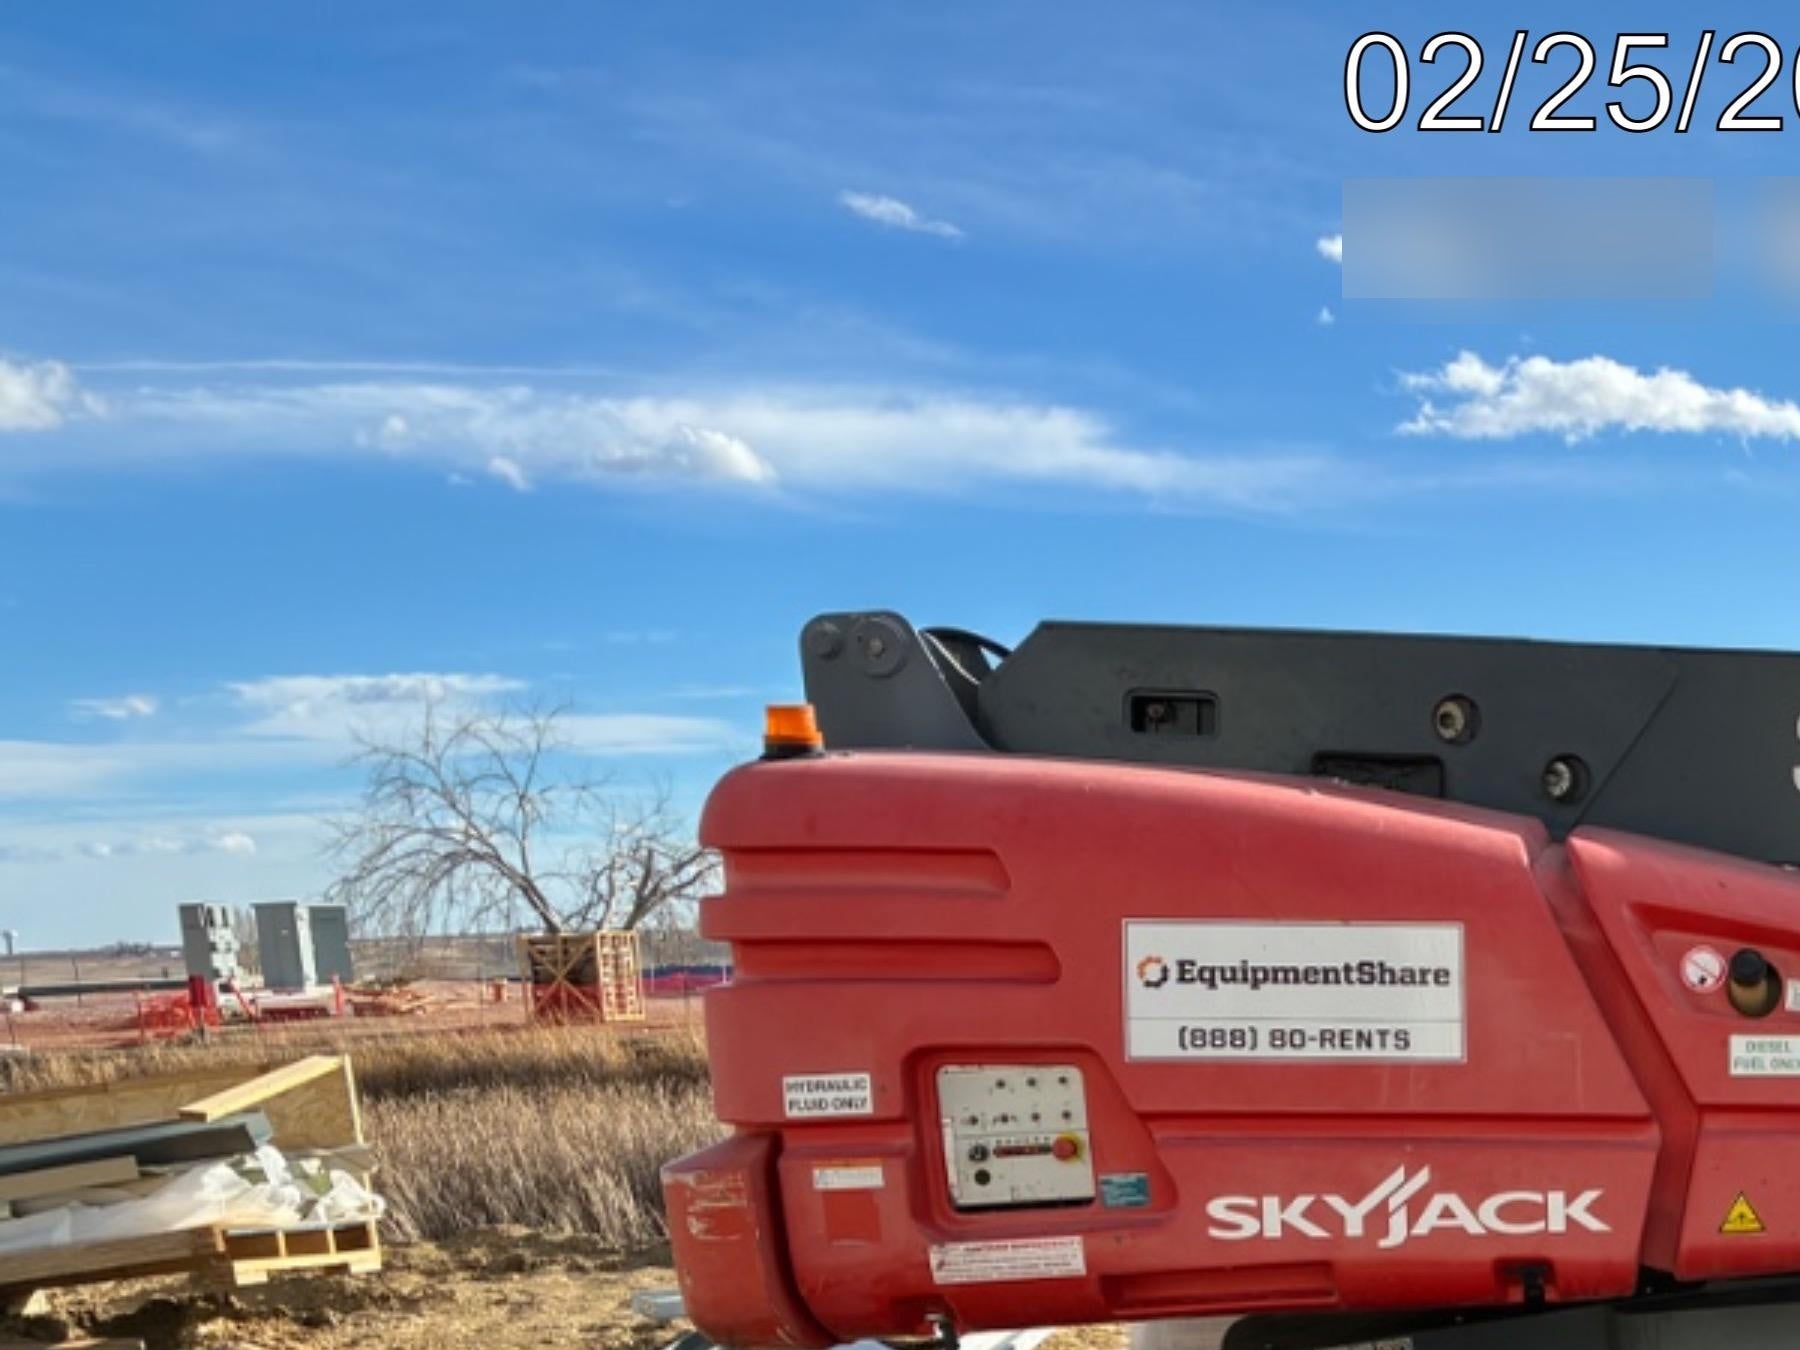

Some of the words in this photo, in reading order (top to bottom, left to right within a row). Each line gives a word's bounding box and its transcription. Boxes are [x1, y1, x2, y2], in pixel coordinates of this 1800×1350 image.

[1176, 959, 1450, 990] EquipmentShare
[1178, 1025, 1258, 1051] (888)
[1269, 1028, 1411, 1050] 80-RENTS
[1205, 1164, 1612, 1249] SKYJACK
